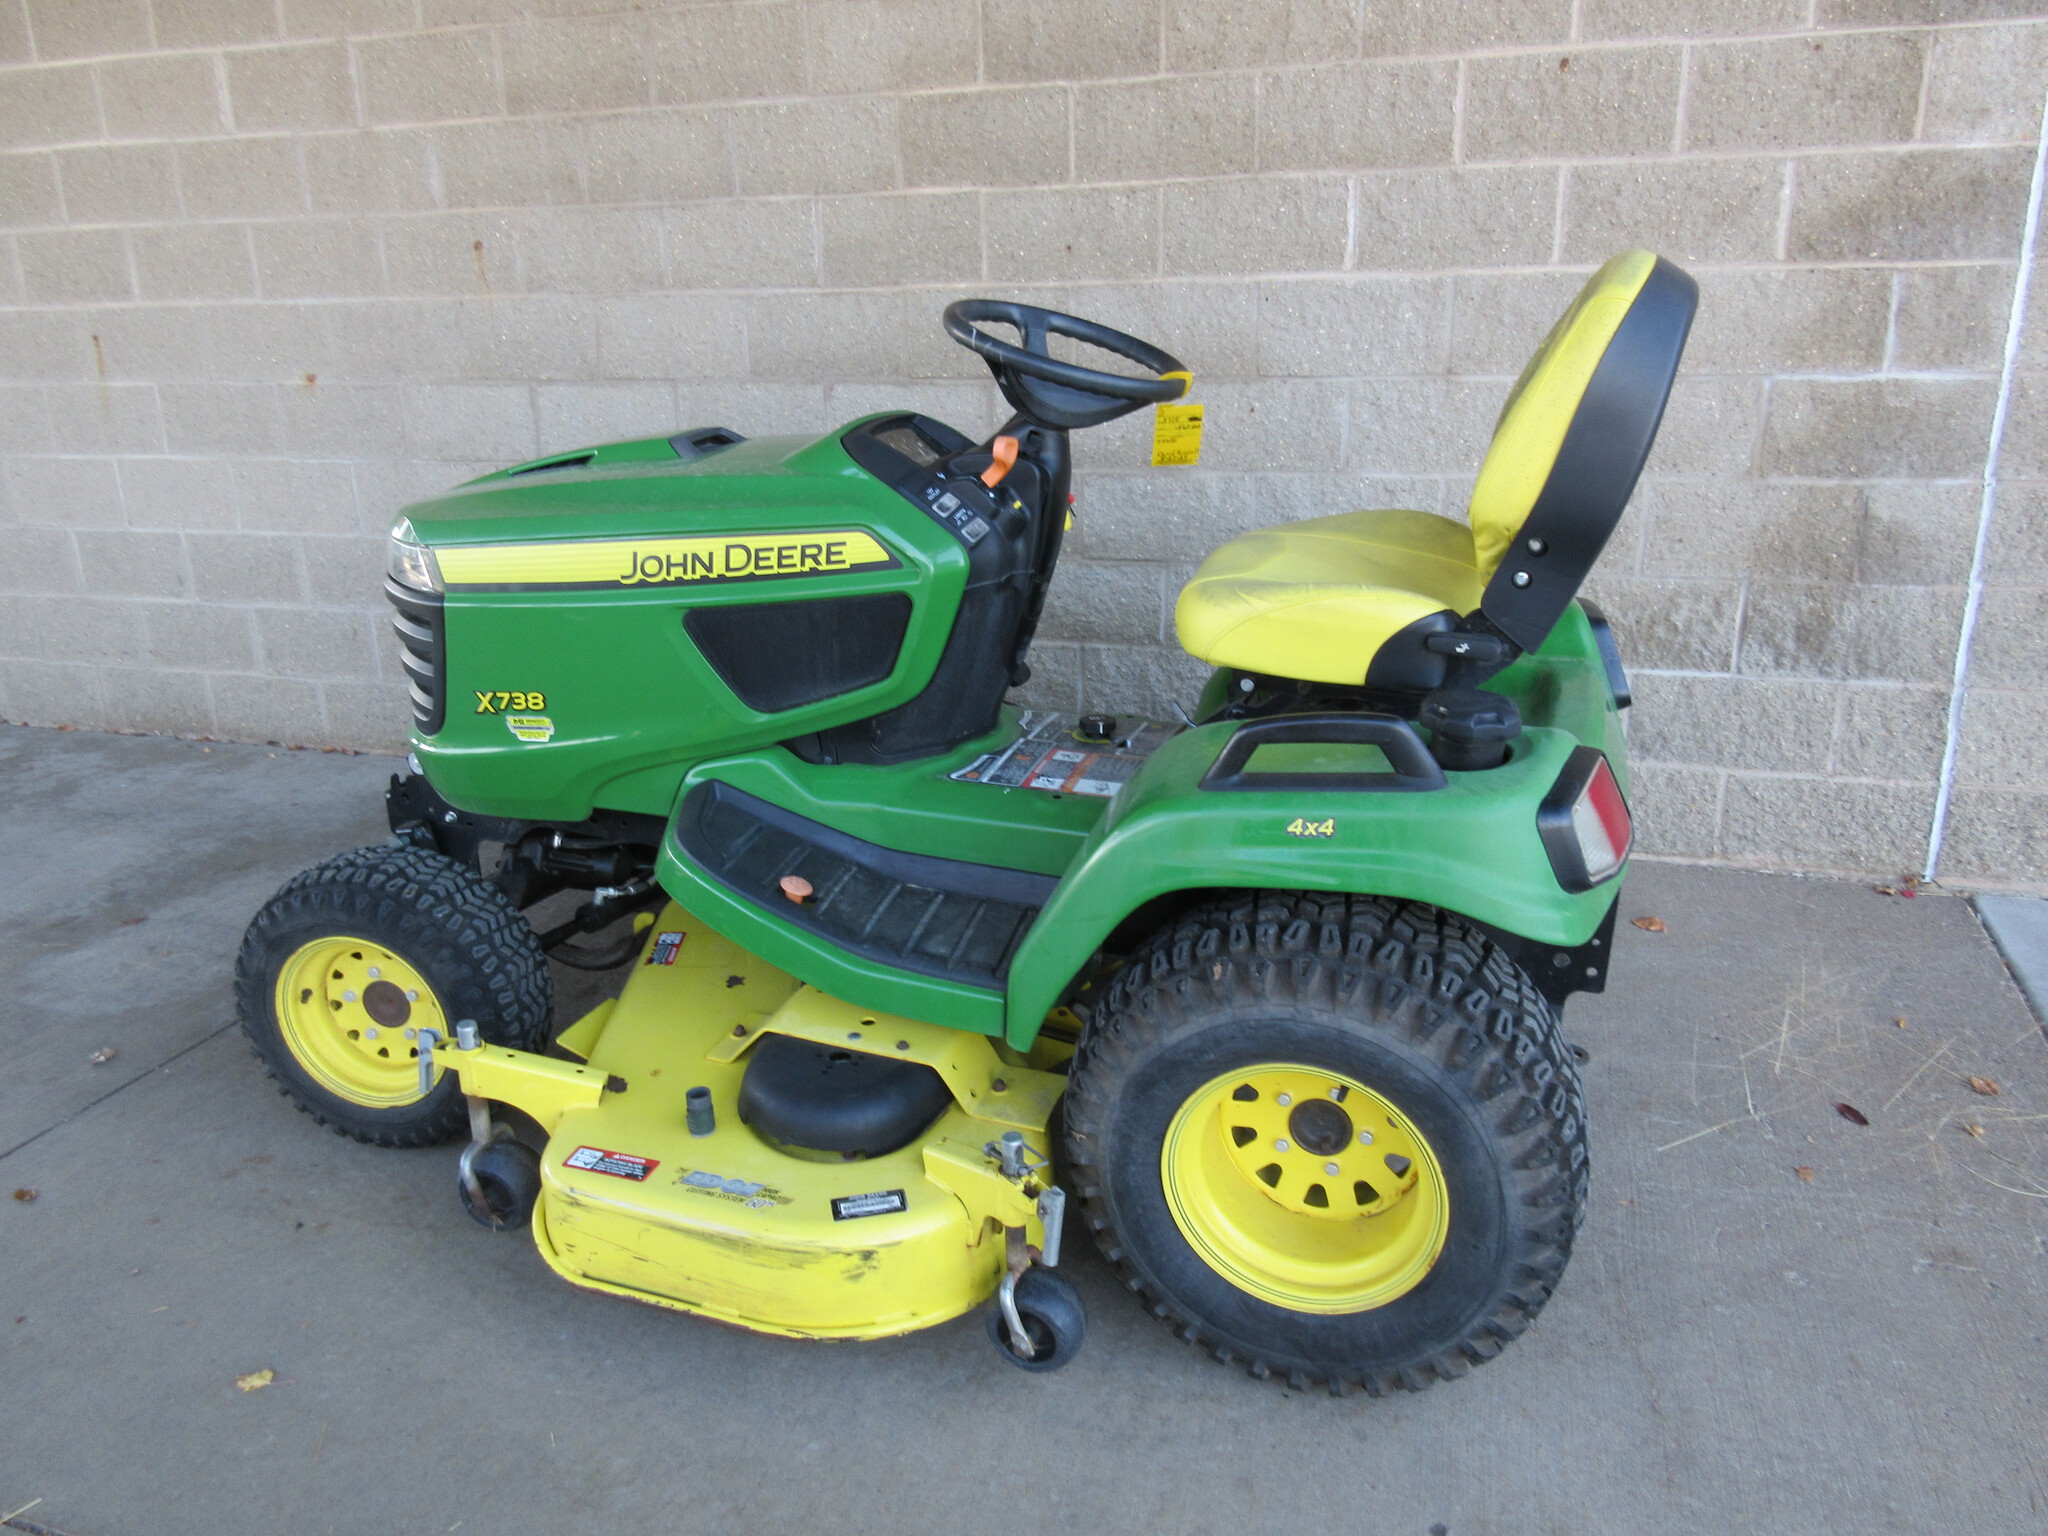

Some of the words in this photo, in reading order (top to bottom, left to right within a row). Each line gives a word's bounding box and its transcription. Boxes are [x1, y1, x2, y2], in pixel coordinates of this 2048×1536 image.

[620, 551, 714, 581] JOHN
[725, 541, 847, 573] DEERE
[474, 690, 547, 715] X738
[1286, 817, 1335, 837] 4x4
